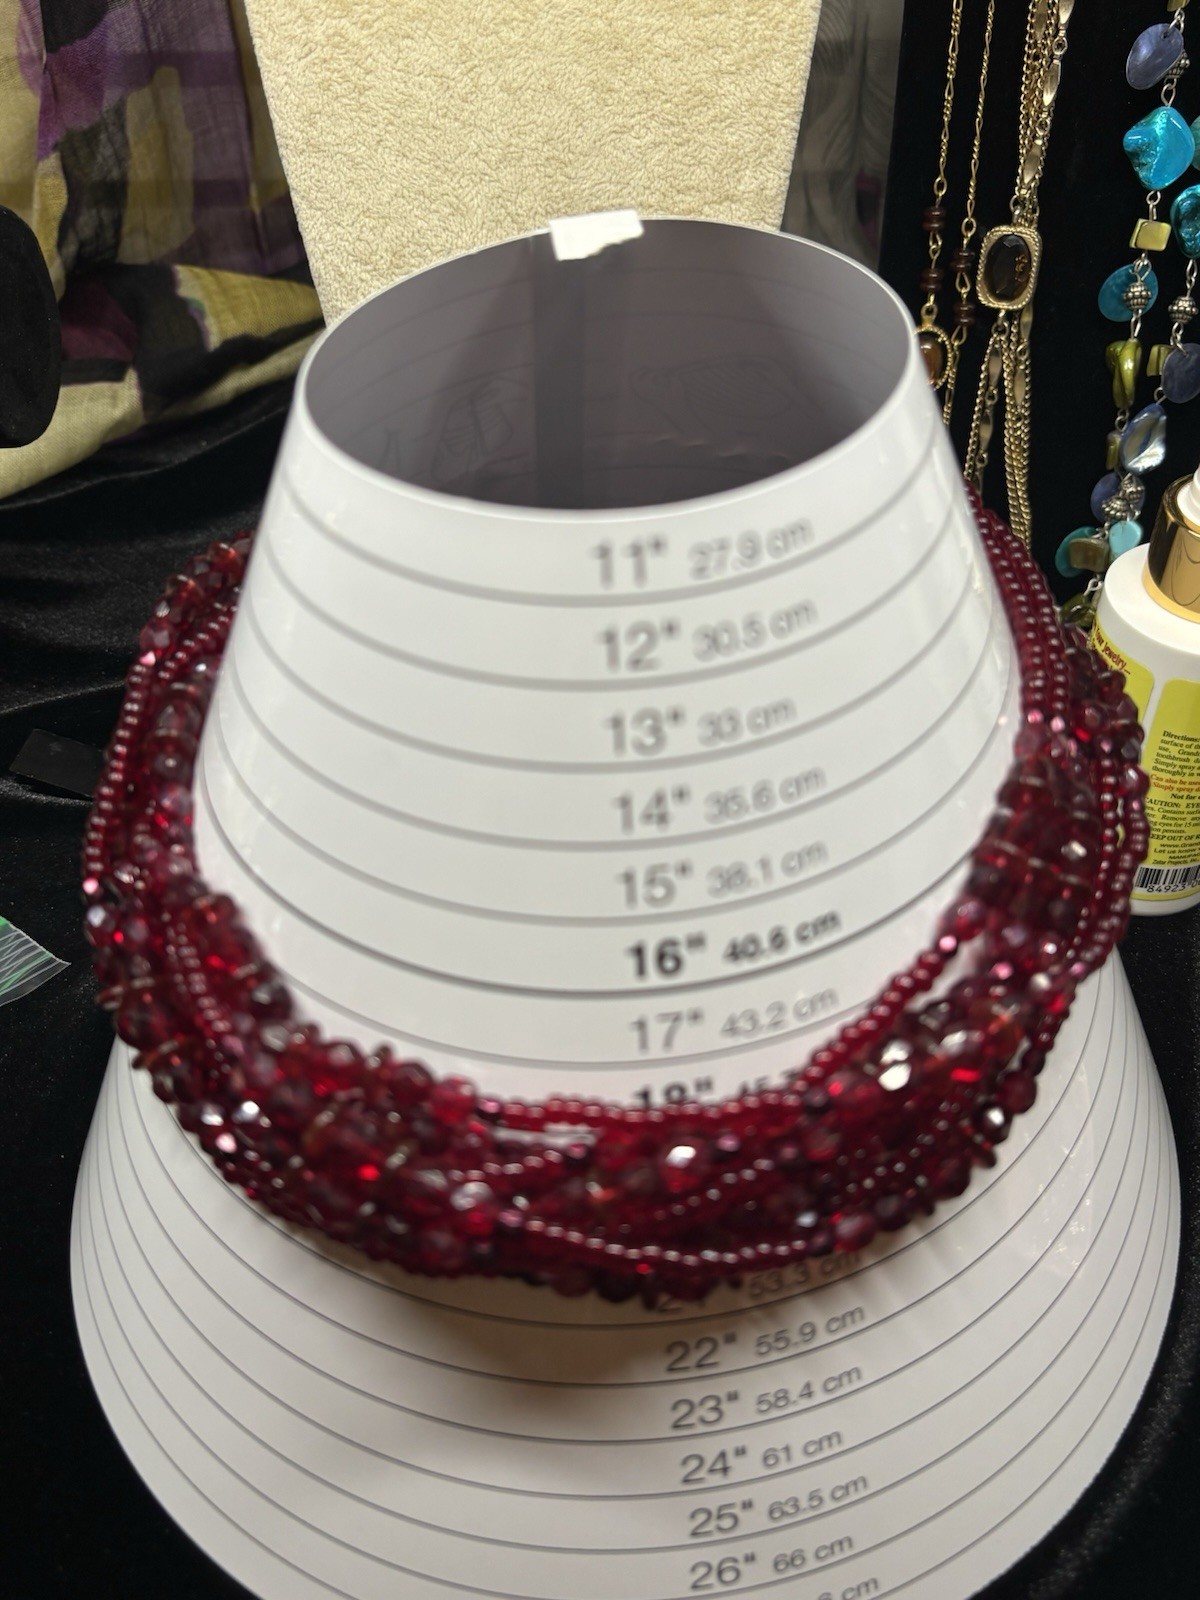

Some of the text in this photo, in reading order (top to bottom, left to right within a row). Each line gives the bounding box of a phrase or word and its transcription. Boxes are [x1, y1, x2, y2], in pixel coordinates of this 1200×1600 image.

[591, 518, 815, 589] 11" 27.9 cm
[599, 617, 680, 673] 12"
[769, 600, 818, 639] cm
[605, 698, 797, 757] 13" 33 cm
[612, 784, 691, 835] 14"
[779, 767, 827, 805] cm
[616, 841, 828, 910] 15" 38.1 cm
[626, 911, 841, 979] 16" 40.6 cm
[629, 988, 839, 1054] 17" 43.2 cm
[665, 1306, 865, 1372] 22" 55.9 cm
[670, 1366, 863, 1429] 23" 58.4 cm
[680, 1430, 843, 1485] 24" 61 cm
[689, 1475, 868, 1538] 25" 63.5 cm
[689, 1535, 854, 1592] 26" 66 cm
[841, 1577, 879, 1600] cm
